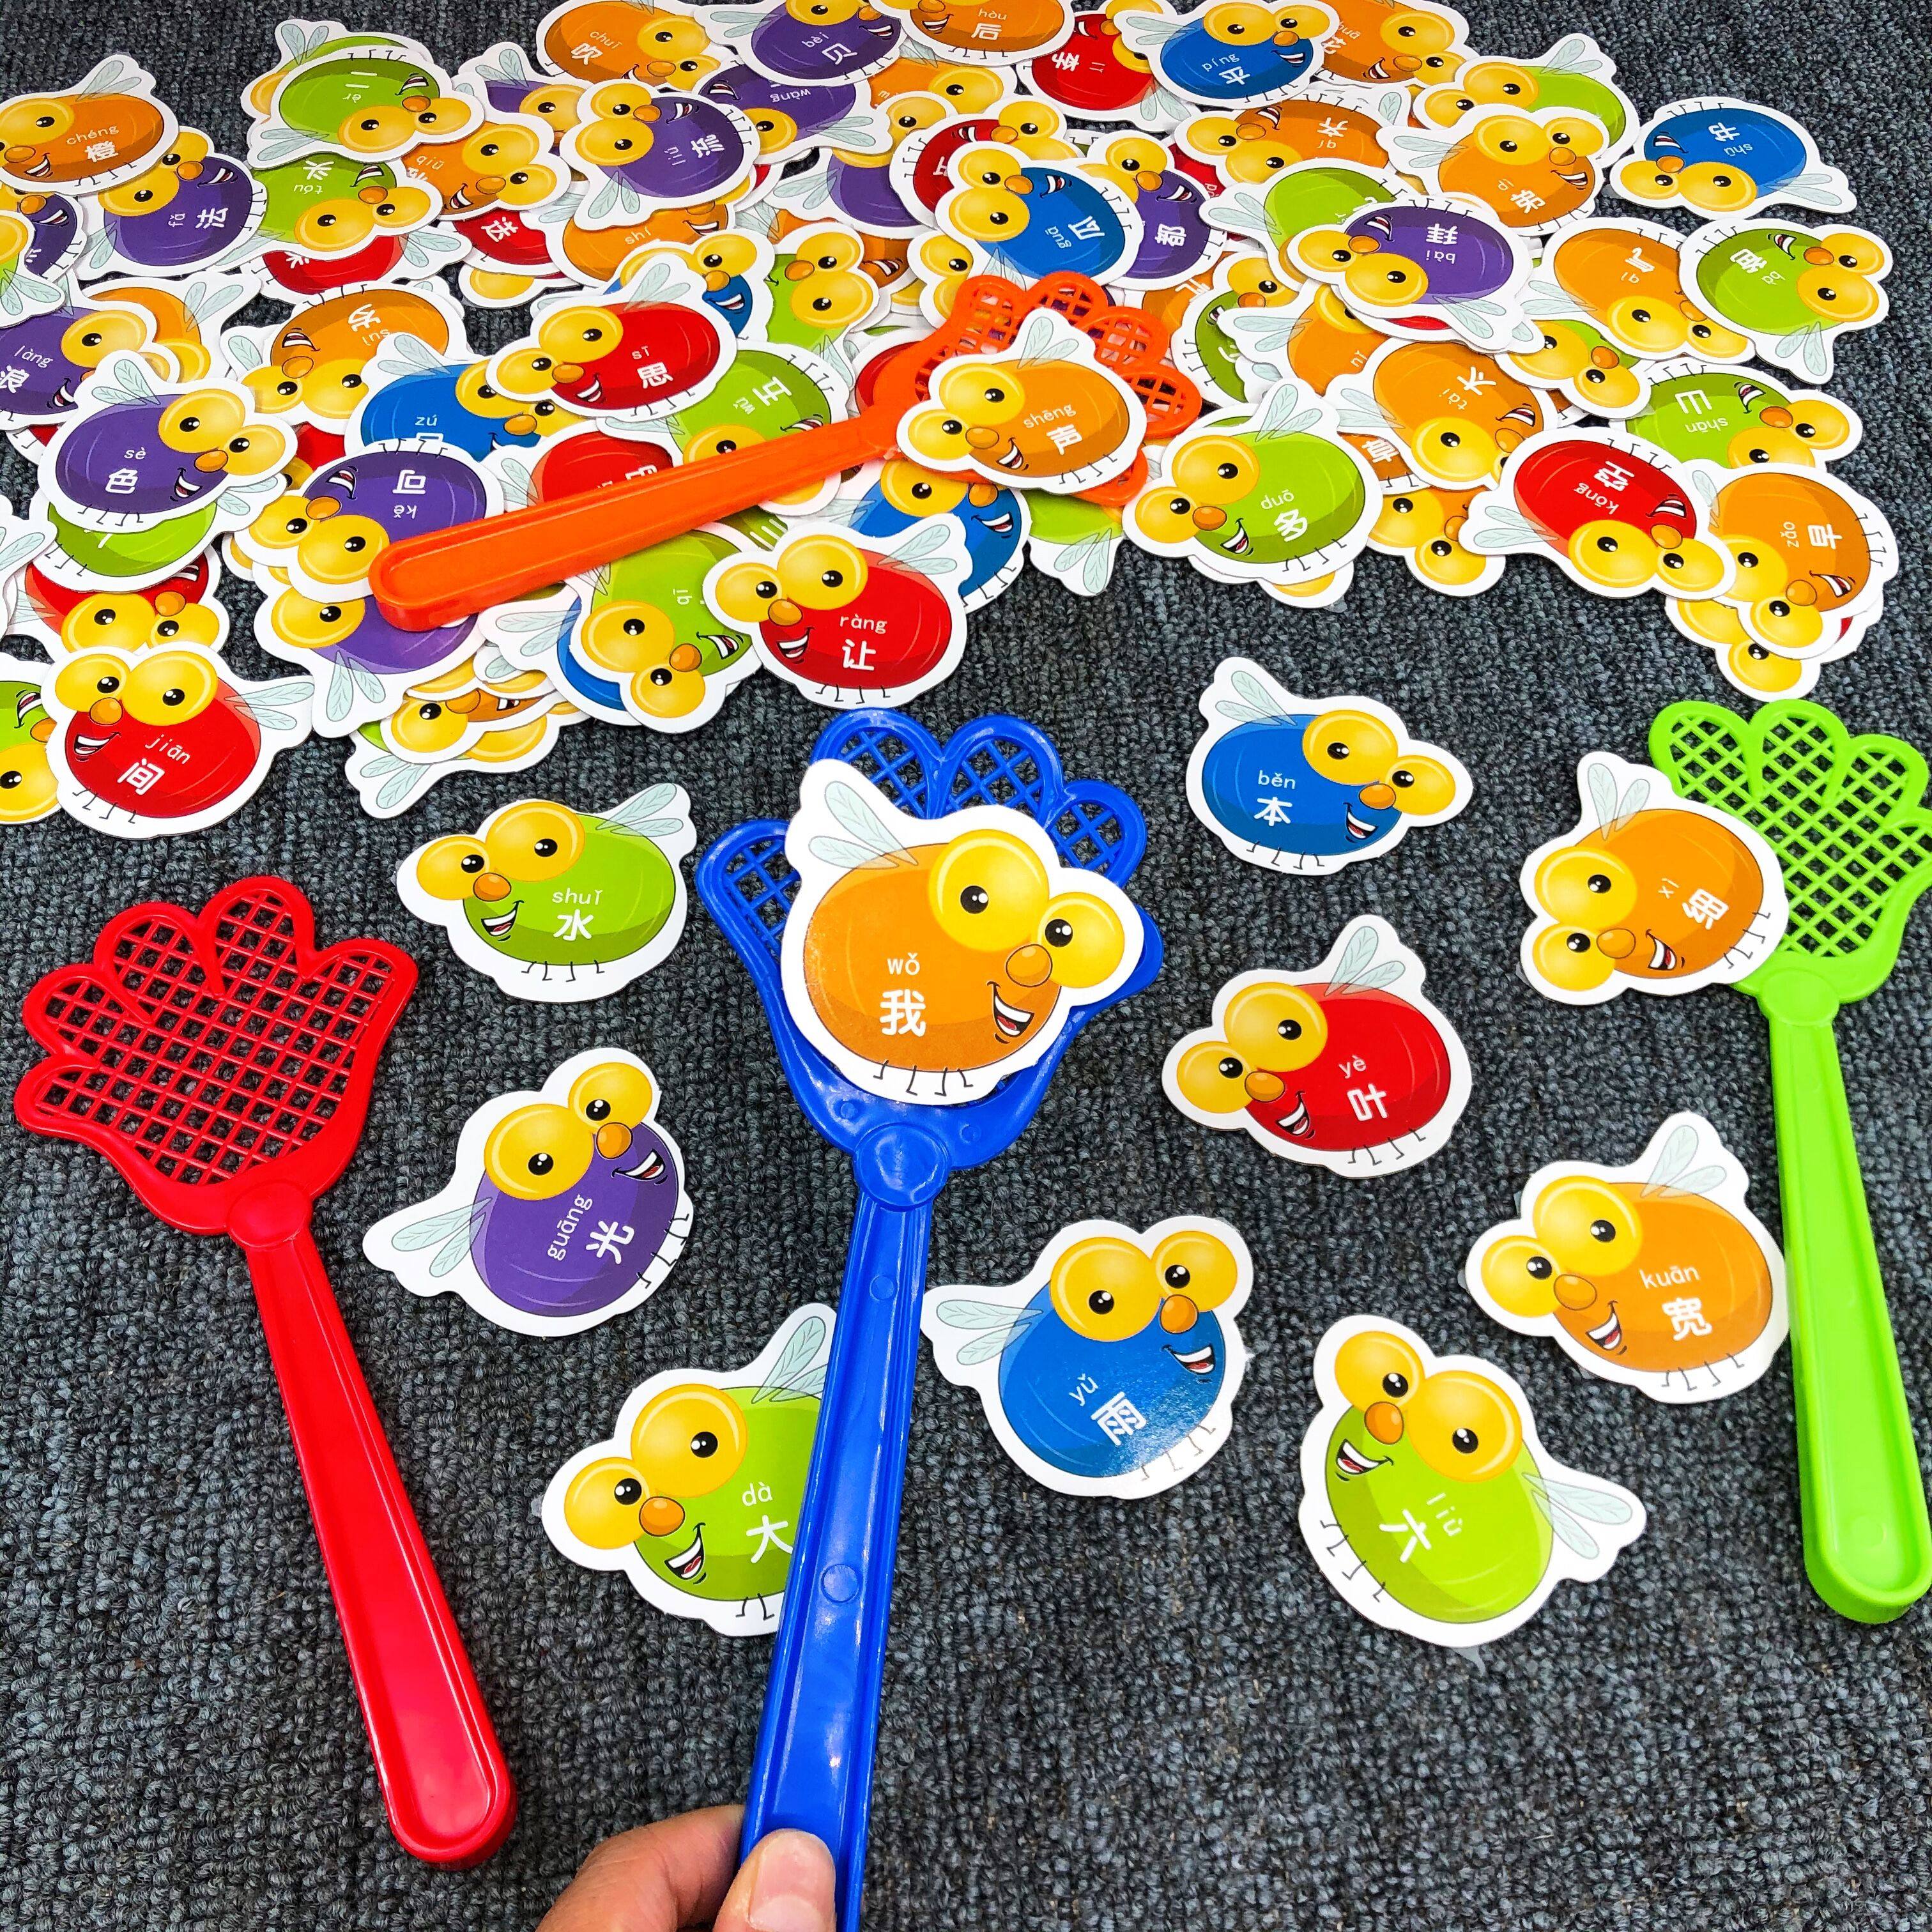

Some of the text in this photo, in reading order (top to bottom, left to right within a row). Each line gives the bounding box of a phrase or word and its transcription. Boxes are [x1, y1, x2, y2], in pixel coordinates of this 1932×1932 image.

[978, 8, 1007, 20] hòu
[590, 32, 622, 48] chuī
[802, 32, 829, 47] bèi
[971, 23, 1002, 40] 后
[571, 43, 602, 65] 吹
[822, 43, 857, 65] 贝
[1052, 52, 1079, 72] 李
[1202, 54, 1239, 72] píng
[346, 72, 377, 88] 二
[1219, 66, 1250, 84] 平
[342, 93, 361, 103] èr
[770, 89, 811, 102] wàng
[66, 126, 119, 144] chéng
[1317, 118, 1348, 137] 齐
[1708, 123, 1740, 141] 书
[85, 141, 118, 162] 橙
[691, 134, 724, 158] 流
[1317, 140, 1336, 148] qí
[1724, 144, 1752, 156] shū
[417, 156, 444, 169] qiū
[664, 146, 686, 165] liú
[303, 160, 334, 180] 头
[294, 185, 322, 194] tóu
[1510, 190, 1545, 213] 弟
[168, 213, 185, 227] fǎ
[195, 208, 228, 229] 法
[481, 217, 518, 242] 送
[1068, 216, 1105, 240] 瓜
[625, 226, 651, 244] shí
[1045, 226, 1071, 248] guā
[1154, 224, 1186, 247] 都
[1426, 224, 1458, 244] 拜
[1427, 250, 1455, 264] bài
[1625, 247, 1655, 272] 气
[1730, 249, 1767, 273] 爸
[1761, 271, 1785, 284] bà
[348, 304, 381, 332] 岁
[14, 346, 53, 368] làng
[631, 345, 650, 360] sī
[0, 365, 29, 394] 浪
[637, 362, 673, 388] 思
[1457, 367, 1496, 395] 太
[753, 376, 792, 406] 五
[1439, 388, 1468, 410] tài
[1675, 390, 1712, 414] 山
[733, 397, 755, 414] wǔ
[1023, 404, 1076, 428] shēng
[415, 415, 437, 425] zú
[1685, 418, 1728, 433] shān
[1046, 424, 1082, 455] 声
[124, 447, 146, 459] sè
[105, 468, 138, 494] 色
[392, 470, 426, 494] 可
[1594, 461, 1634, 491] 空
[1261, 489, 1294, 509] duō
[1574, 483, 1619, 514] kōng
[394, 505, 417, 519] kě
[1274, 509, 1308, 542] 多
[1780, 521, 1799, 548] zǎo
[1808, 524, 1842, 549] 早
[840, 614, 887, 634] ràng
[842, 639, 876, 670] 让
[142, 734, 190, 765] jiān
[118, 758, 165, 795] 间
[1259, 770, 1295, 789] běn
[1254, 797, 1292, 826] 本
[552, 887, 602, 905] shuǐ
[1659, 878, 1679, 899] xì
[1682, 889, 1729, 930] 细
[554, 909, 594, 940] 水
[887, 953, 920, 975] wǒ
[880, 989, 926, 1036] 我
[1338, 1055, 1366, 1078] yè
[1347, 1084, 1387, 1121] 叶
[548, 1194, 593, 1261] guāng
[586, 1221, 634, 1264] 光
[1639, 1266, 1699, 1289] kuān
[1662, 1298, 1712, 1340] 宽
[1069, 1374, 1098, 1406] yǔ
[1091, 1392, 1149, 1446] 雨
[742, 1482, 772, 1506] dà
[1427, 1492, 1462, 1537] liù
[746, 1515, 793, 1563] 大
[1379, 1509, 1431, 1563] 六
